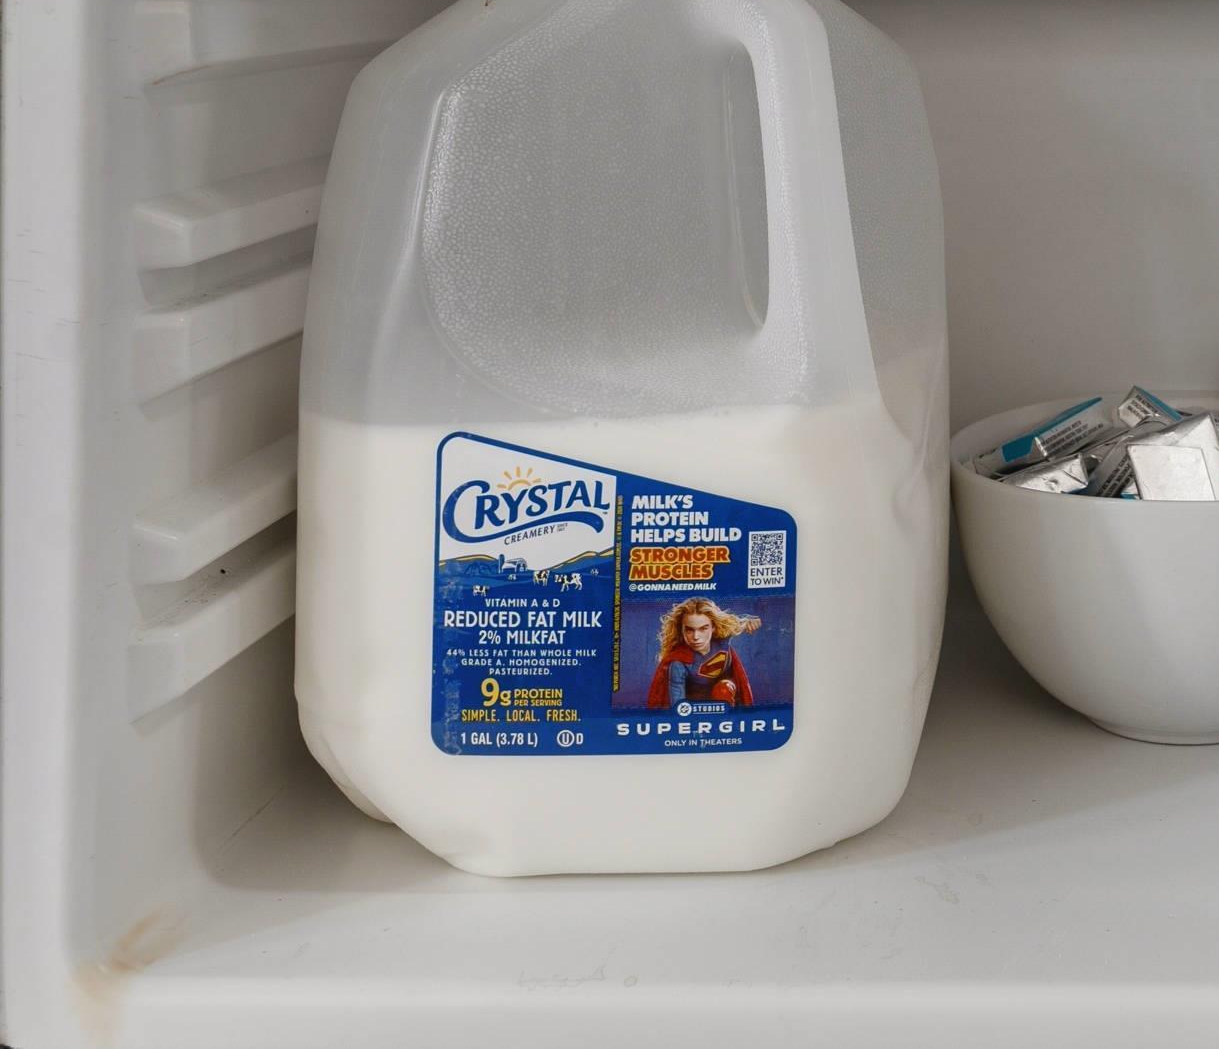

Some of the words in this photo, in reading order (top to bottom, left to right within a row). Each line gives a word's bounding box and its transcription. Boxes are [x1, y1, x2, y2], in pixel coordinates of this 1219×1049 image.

[631, 495, 693, 510] MILK'S
[443, 480, 610, 543] CRYSTAL
[631, 511, 709, 527] PROTEIN
[504, 525, 557, 546] CREAMERY
[630, 528, 687, 543] HELPS
[689, 527, 742, 542] BUILD
[629, 546, 731, 563] STRONGER
[629, 563, 714, 581] MUSCLES
[750, 567, 783, 577] ENTER
[750, 577, 761, 586] TO
[485, 598, 528, 608] VITAMIN
[530, 598, 539, 608] A
[542, 598, 550, 608] &
[552, 598, 561, 608] D
[444, 610, 521, 628] REDUCED
[527, 610, 557, 628] FAT
[562, 610, 603, 628] MILK
[478, 630, 501, 645] 2%
[506, 630, 566, 645] MILKFAT
[446, 649, 466, 657] 44%
[469, 649, 490, 657] LESS
[492, 649, 509, 657] FAT
[512, 649, 537, 657] THAN
[540, 649, 572, 657] WHOLE
[575, 649, 597, 657] MILK
[461, 658, 493, 666] GRADE
[495, 658, 506, 666] A.
[509, 658, 582, 666] HOMOGENIZED.
[489, 667, 553, 676] PASTEURIZED.
[480, 677, 512, 707] 9g
[513, 688, 563, 699] PROTEIN
[513, 699, 529, 707] PER
[530, 699, 563, 707] SERVING
[692, 704, 726, 713] STUDIOS
[461, 709, 501, 723] SIMPLE.
[506, 709, 541, 723] LOCAL.
[546, 709, 582, 723] FRESH.
[616, 718, 786, 736] SUPERGIRL
[460, 733, 466, 745] 1
[470, 732, 493, 746] GAL
[496, 732, 524, 747] (3.78
[527, 732, 539, 747] L)
[664, 739, 687, 747] ONLY
[689, 738, 698, 746] IN
[700, 737, 743, 747] THEATERS
